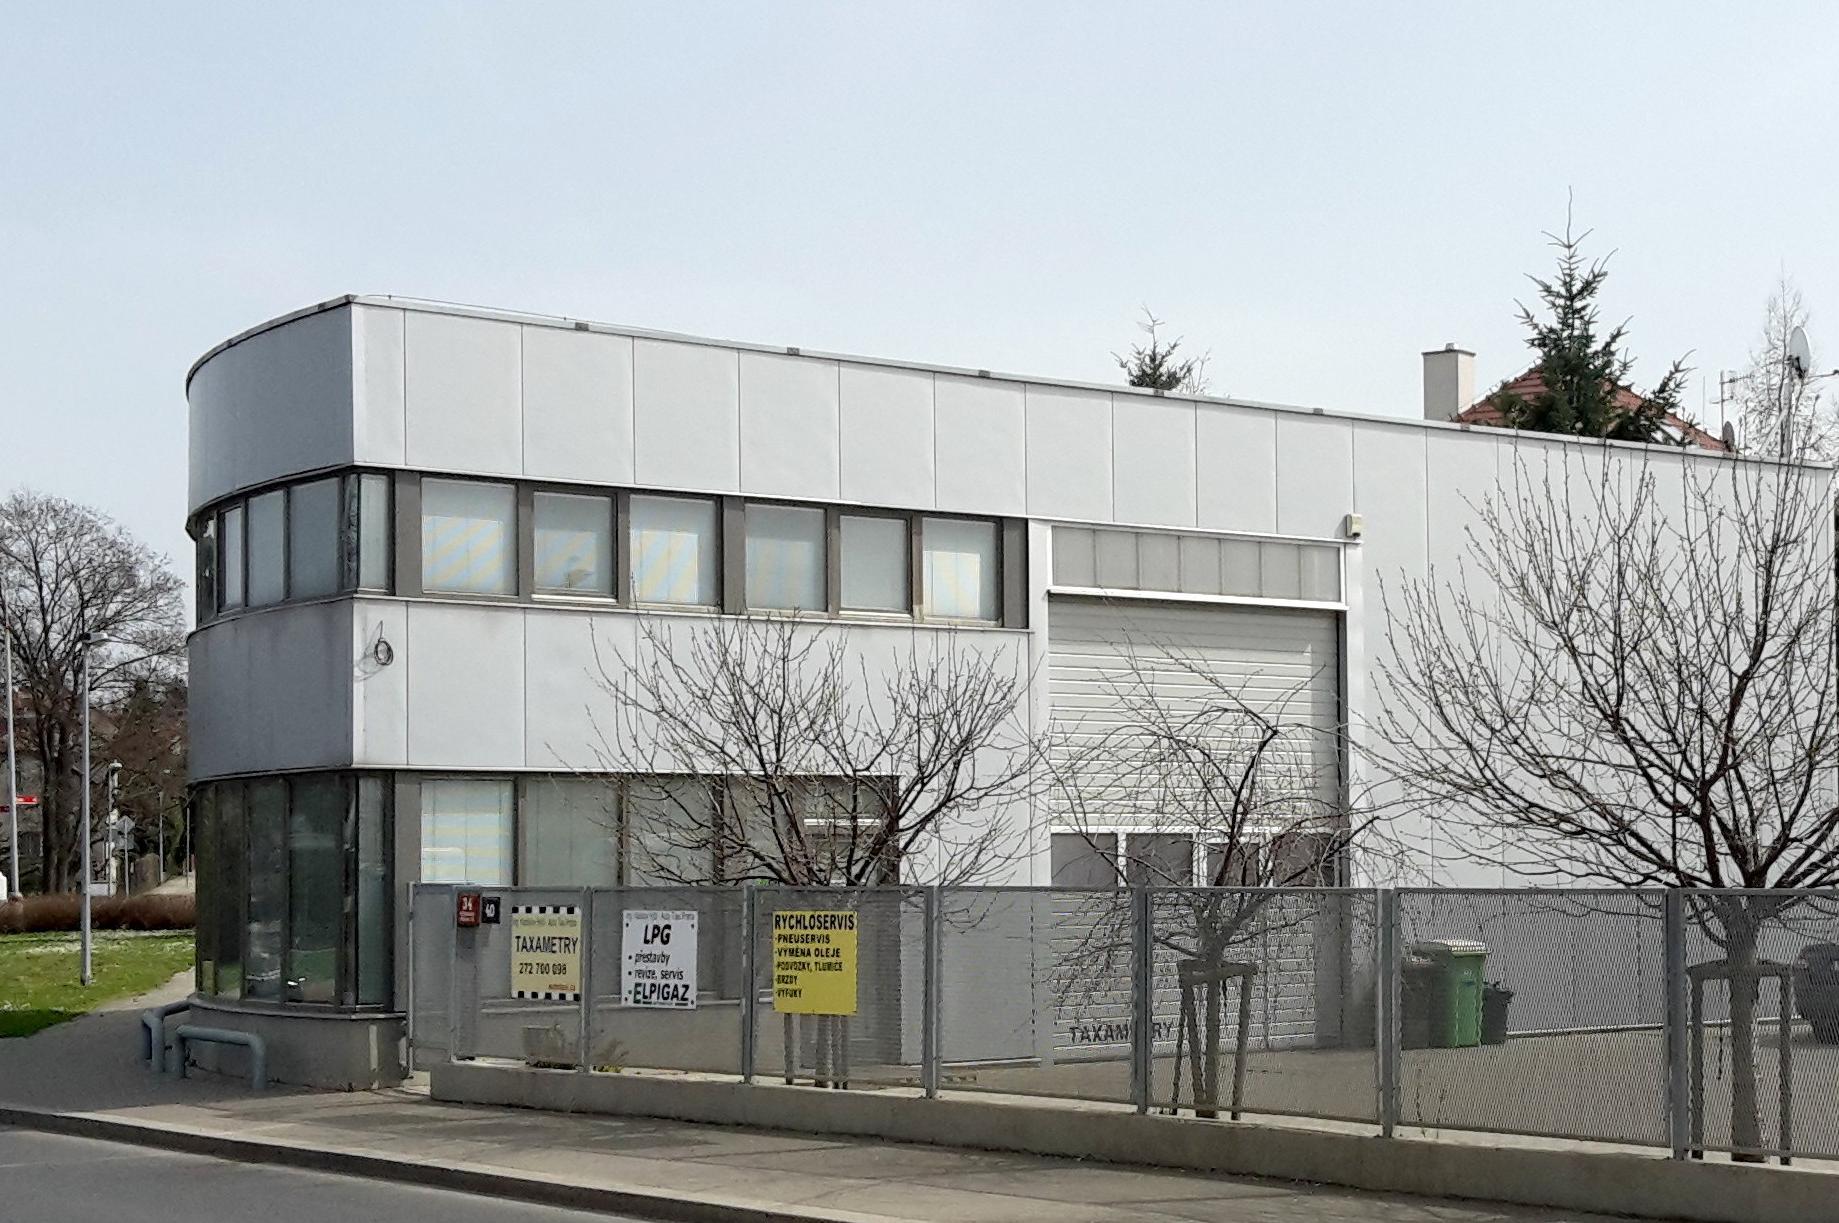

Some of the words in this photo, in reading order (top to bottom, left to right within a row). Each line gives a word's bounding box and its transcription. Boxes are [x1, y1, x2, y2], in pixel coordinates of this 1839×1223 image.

[774, 914, 854, 930] RYCHLOSERVIS
[643, 924, 672, 945] LPG
[777, 933, 831, 944] PNEUSERVIS
[515, 935, 578, 954] TAXAMETRY
[814, 947, 841, 957] OLEJE
[519, 962, 533, 975] 272
[660, 968, 684, 980] servis
[633, 982, 690, 1003] ELPIGAZ
